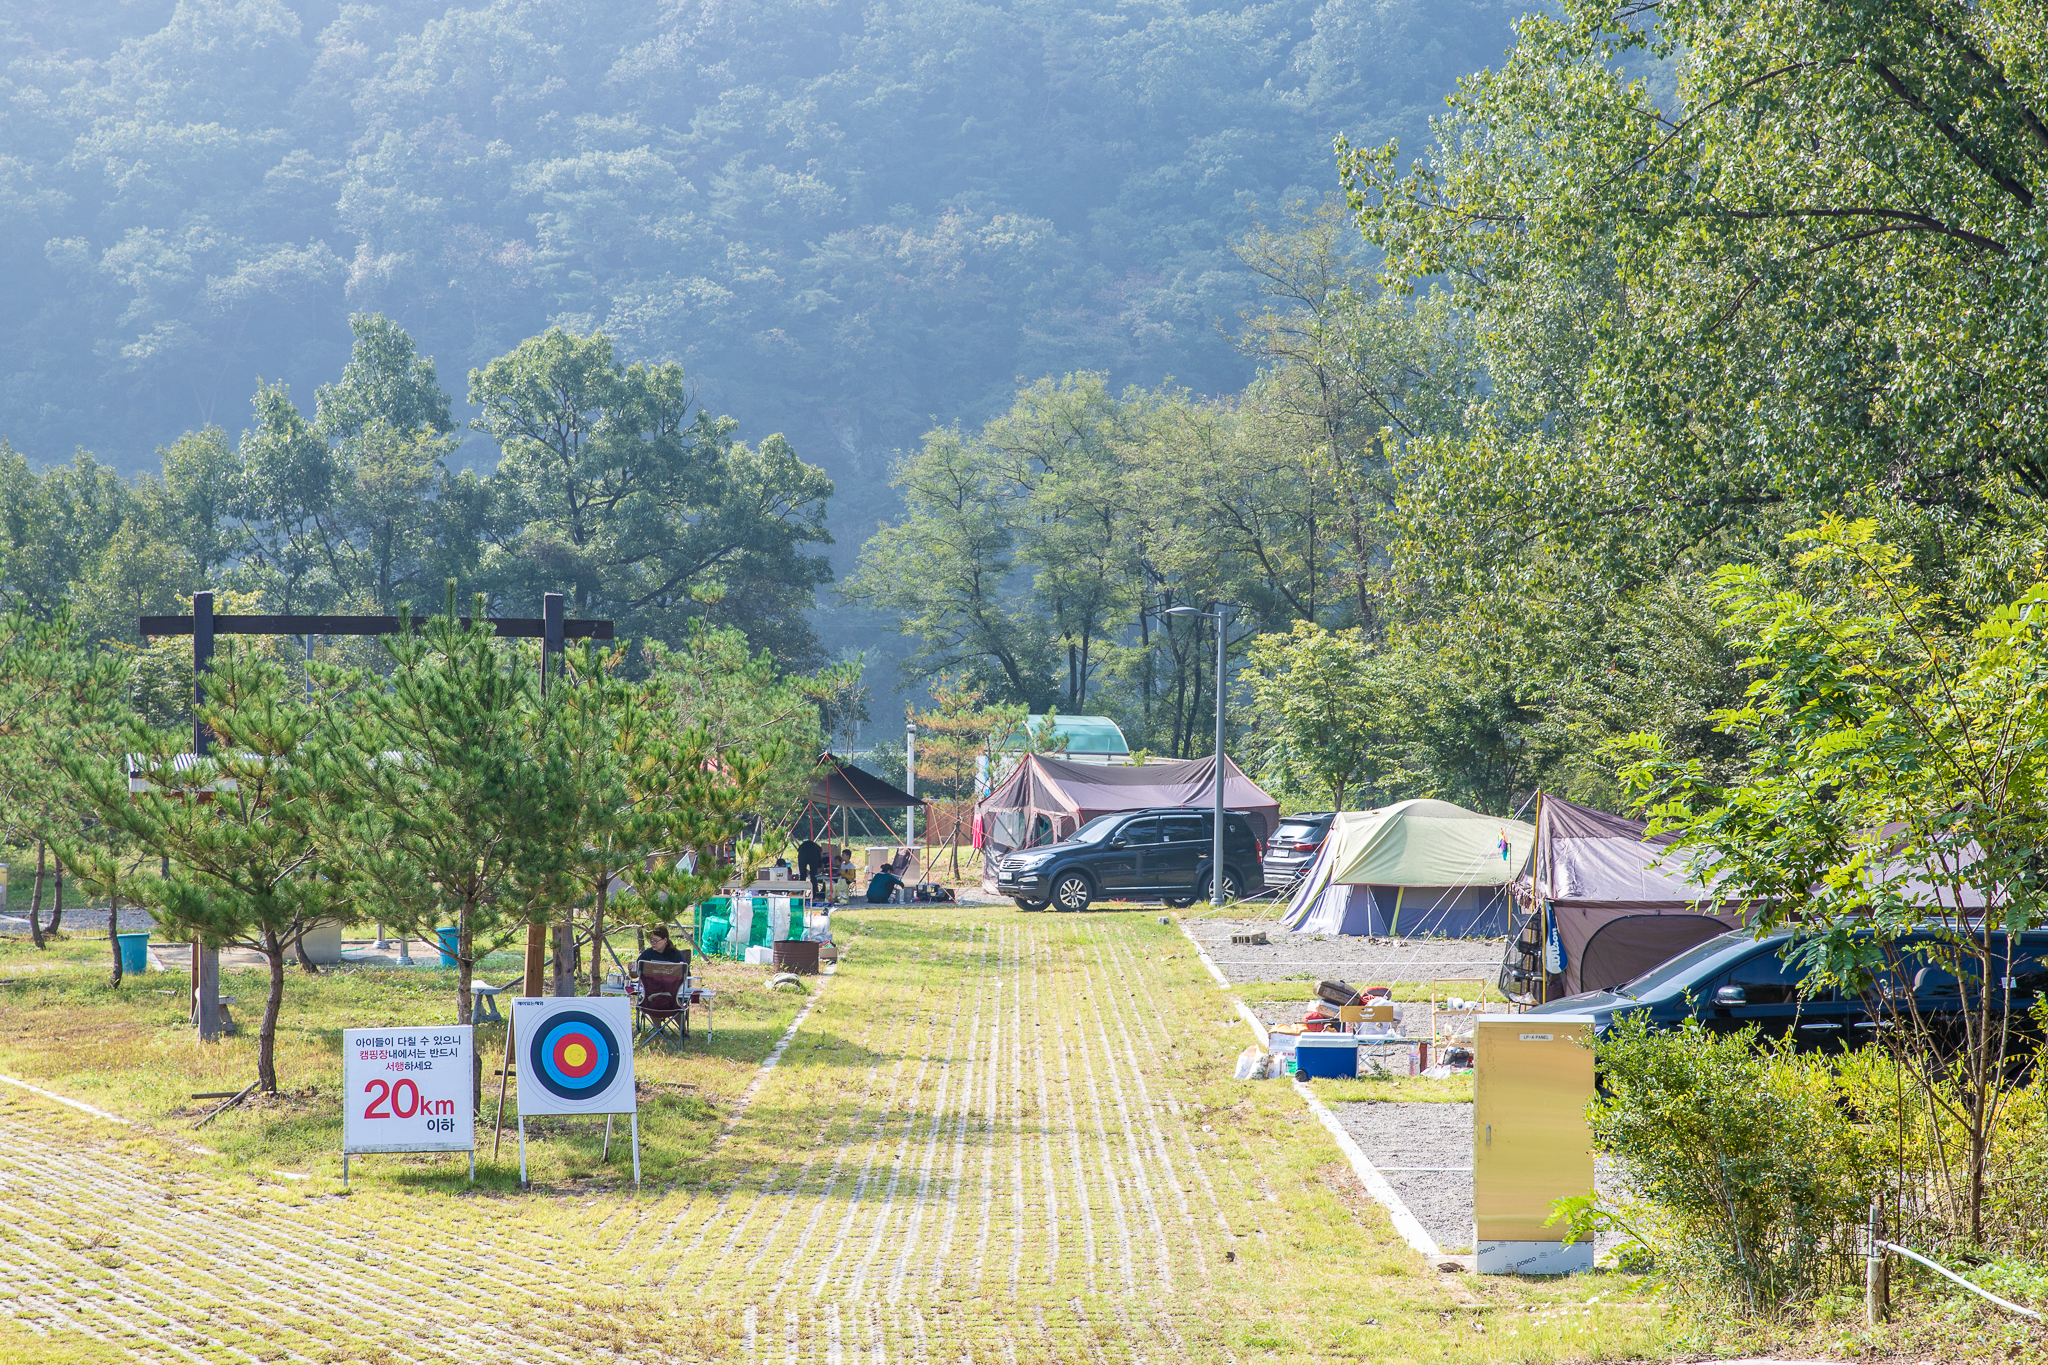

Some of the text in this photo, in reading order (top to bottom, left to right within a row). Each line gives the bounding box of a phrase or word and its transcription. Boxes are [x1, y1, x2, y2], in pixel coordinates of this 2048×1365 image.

[356, 1035, 461, 1048] 아이들이 다칠 수 있으니
[360, 1047, 458, 1060] 캠핑장내에서는 반드시
[385, 1060, 433, 1072] 서행하세요
[364, 1078, 455, 1119] 20km
[427, 1118, 455, 1133] 이하
